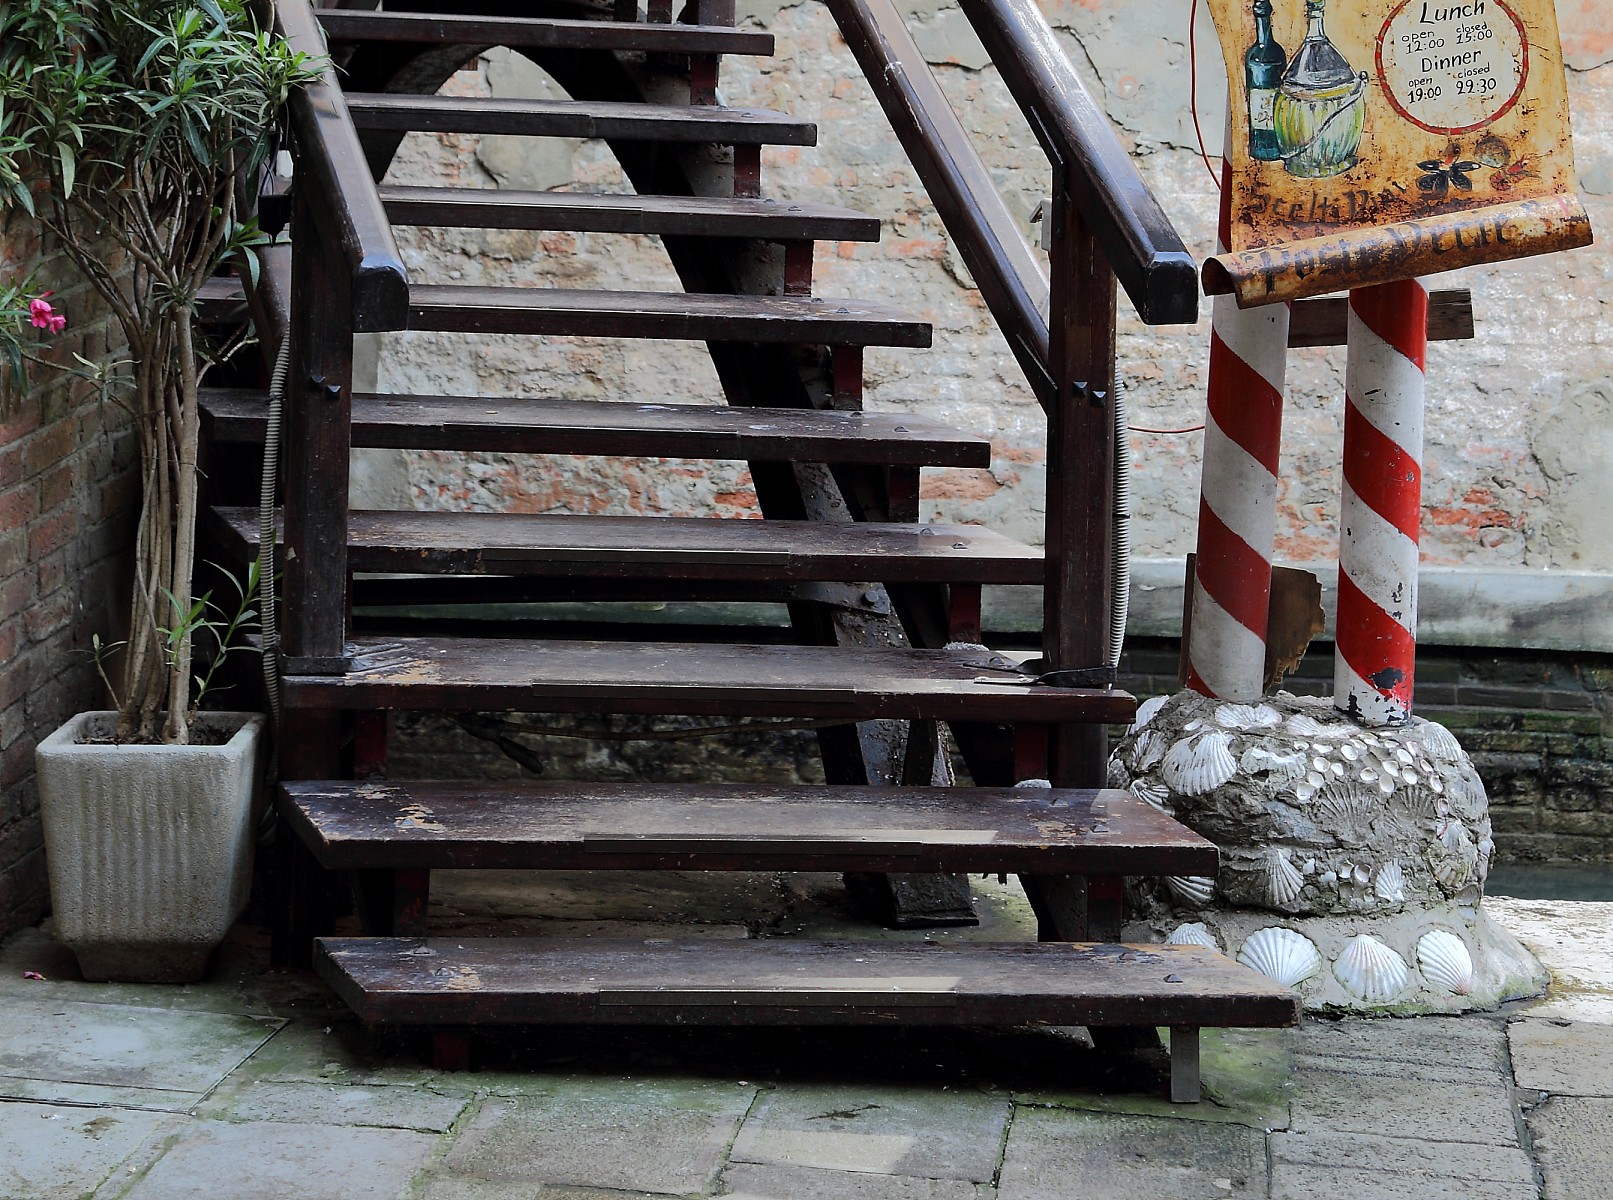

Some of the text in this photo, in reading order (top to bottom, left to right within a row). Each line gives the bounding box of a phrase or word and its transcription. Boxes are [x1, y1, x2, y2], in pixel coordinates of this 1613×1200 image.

[1420, 0, 1485, 25] Lunch
[1401, 21, 1488, 43] open closed
[1405, 29, 1493, 55] 12:00 15:00
[1421, 50, 1482, 73] Dinner
[1408, 62, 1491, 89] open closed
[1407, 77, 1497, 104] 19:00 22:30
